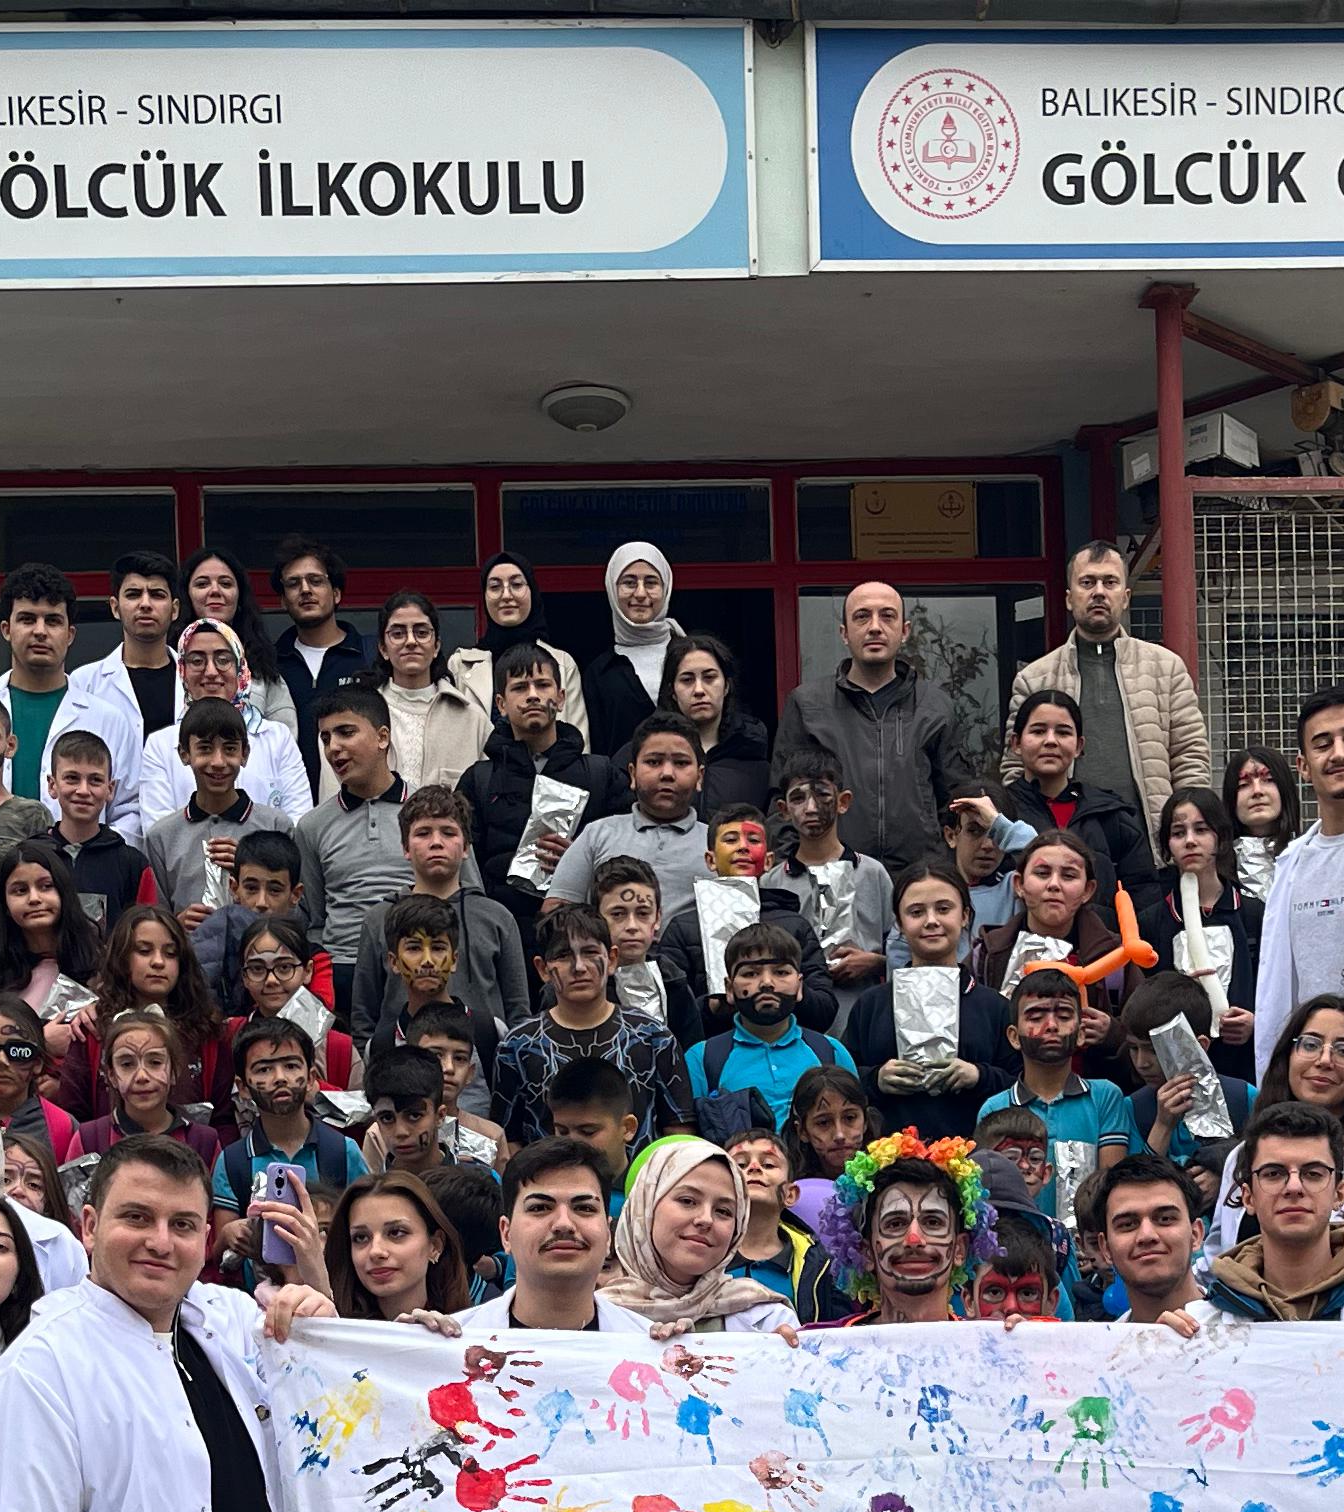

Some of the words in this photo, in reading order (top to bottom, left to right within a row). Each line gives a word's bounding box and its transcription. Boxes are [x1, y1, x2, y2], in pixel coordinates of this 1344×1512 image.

[137, 94, 282, 125] SINDIRGI
[1041, 82, 1197, 117] BALIKESİR
[258, 148, 584, 217] İLKOKULU
[1042, 140, 1307, 206] GÖLCÜK
